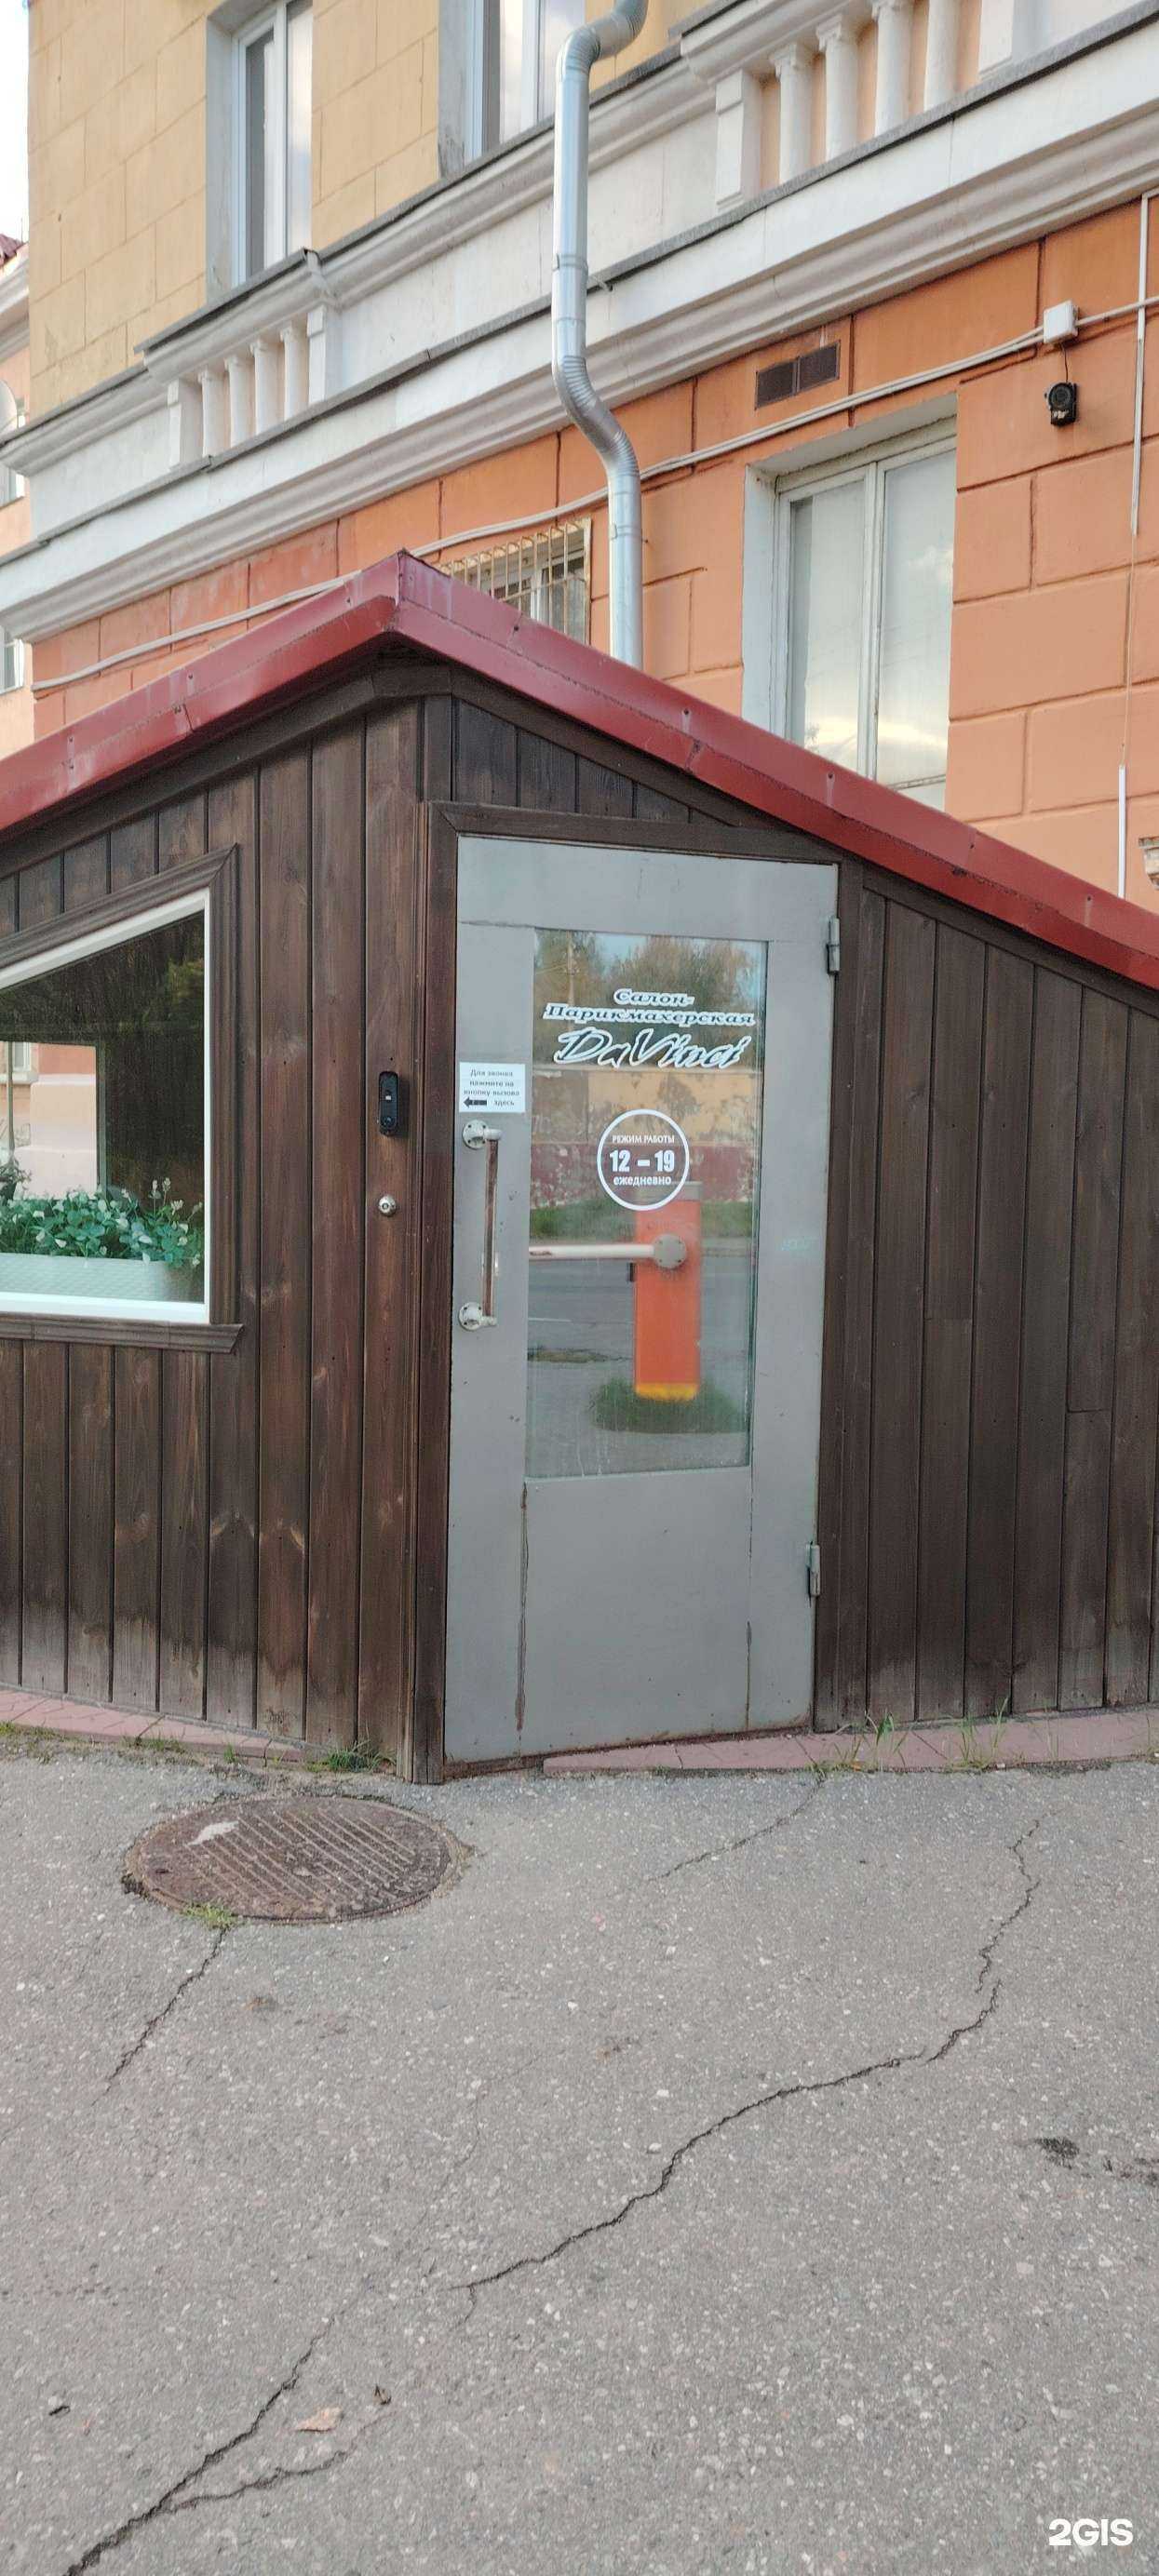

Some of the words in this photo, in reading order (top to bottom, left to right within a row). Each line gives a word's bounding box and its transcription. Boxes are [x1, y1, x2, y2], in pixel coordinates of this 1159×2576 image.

[613, 989, 694, 1007] Салон-
[545, 1003, 754, 1026] Парикмахерская
[470, 1068, 486, 1078] Для
[493, 1099, 515, 1107] здесь
[612, 1134, 642, 1144] РЕЖИМ
[643, 1134, 675, 1144] РАБОТЫ
[609, 1149, 631, 1173] 12
[654, 1149, 675, 1173] 19
[613, 1176, 672, 1187] ежедневно
